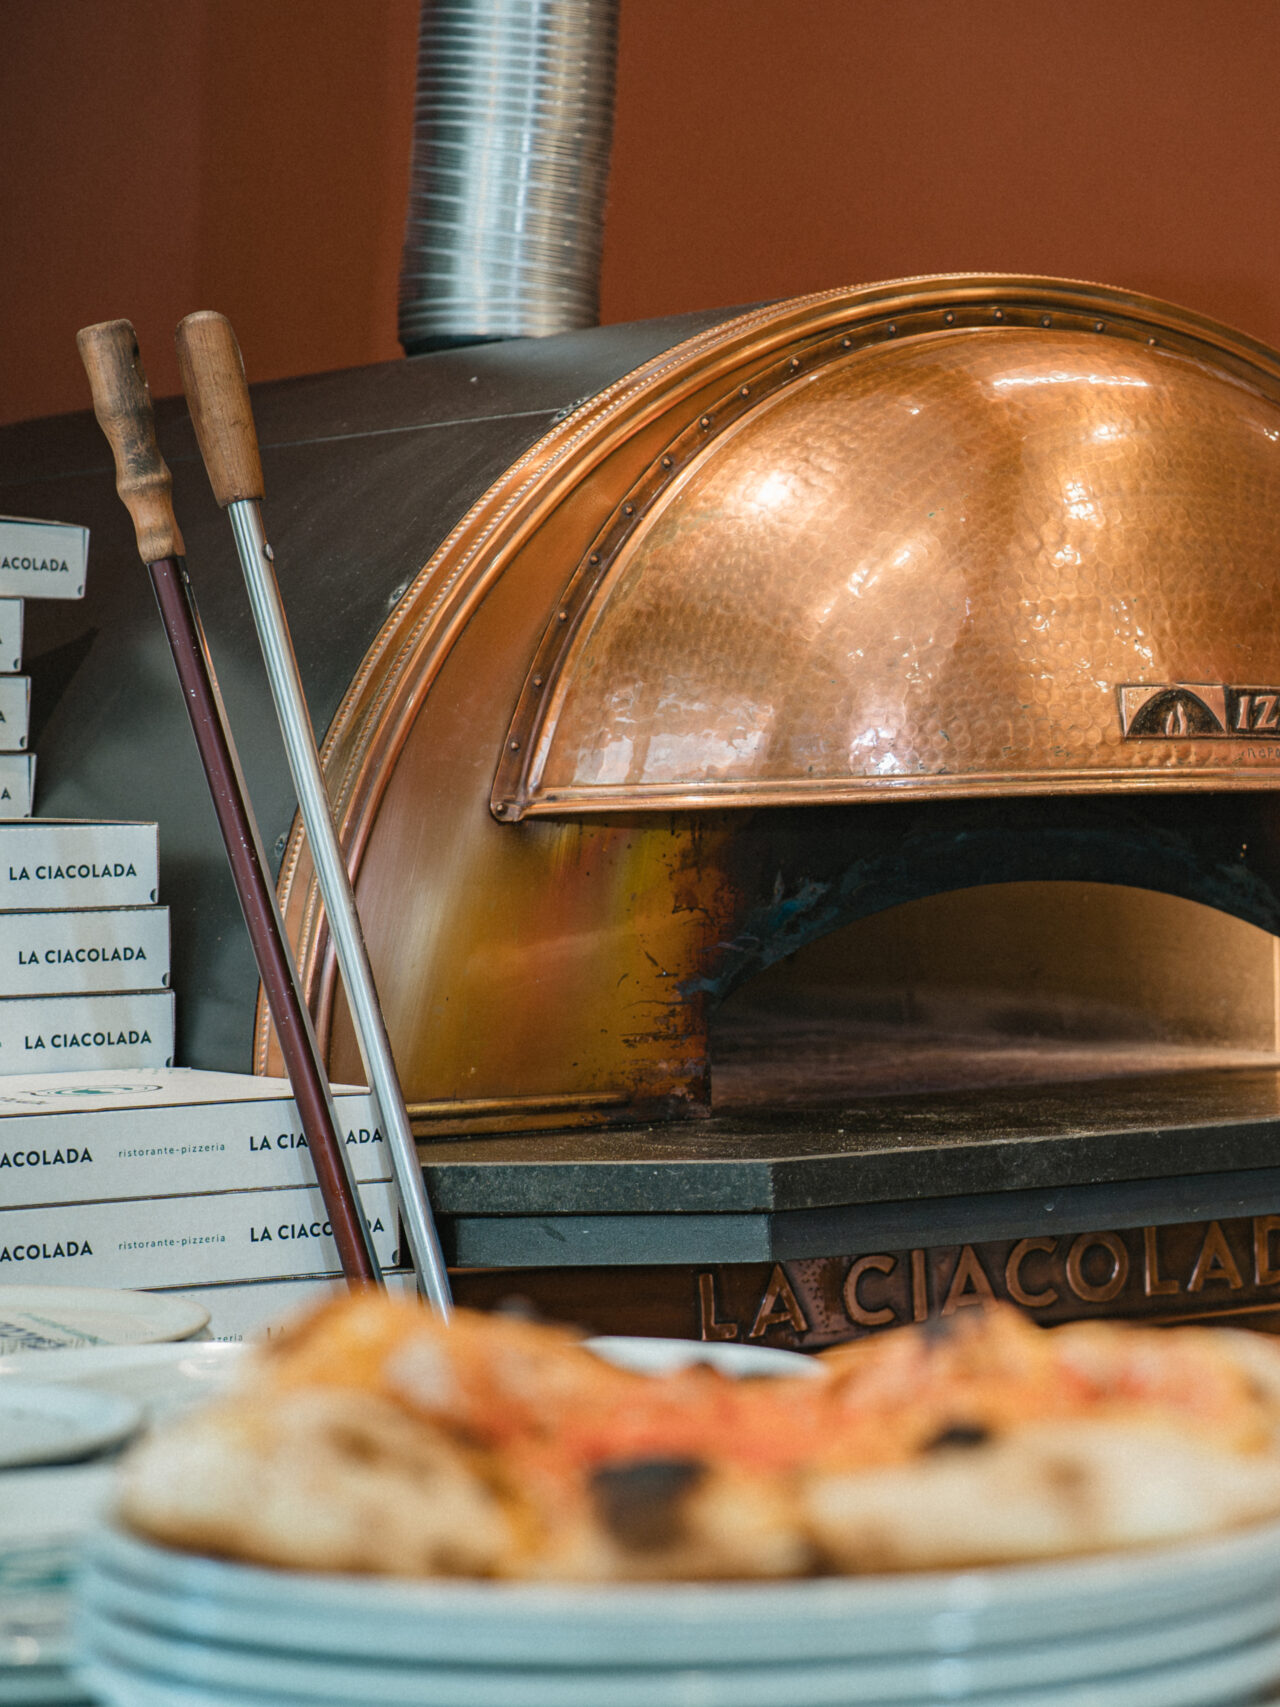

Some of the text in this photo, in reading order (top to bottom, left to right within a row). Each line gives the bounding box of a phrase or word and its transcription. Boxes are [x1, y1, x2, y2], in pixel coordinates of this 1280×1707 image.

[9, 863, 137, 881] LA CIACOLADA
[18, 946, 147, 965] LA CIACOLADA
[24, 1030, 152, 1050] LA CIACOLADA
[118, 1143, 226, 1158] ristorante-pizzeria
[249, 1135, 272, 1151] LA
[277, 1128, 384, 1149] CIAADA
[118, 1234, 226, 1250] ristorante-pizzeria
[250, 1226, 273, 1243] LA
[699, 1263, 808, 1342] LA
